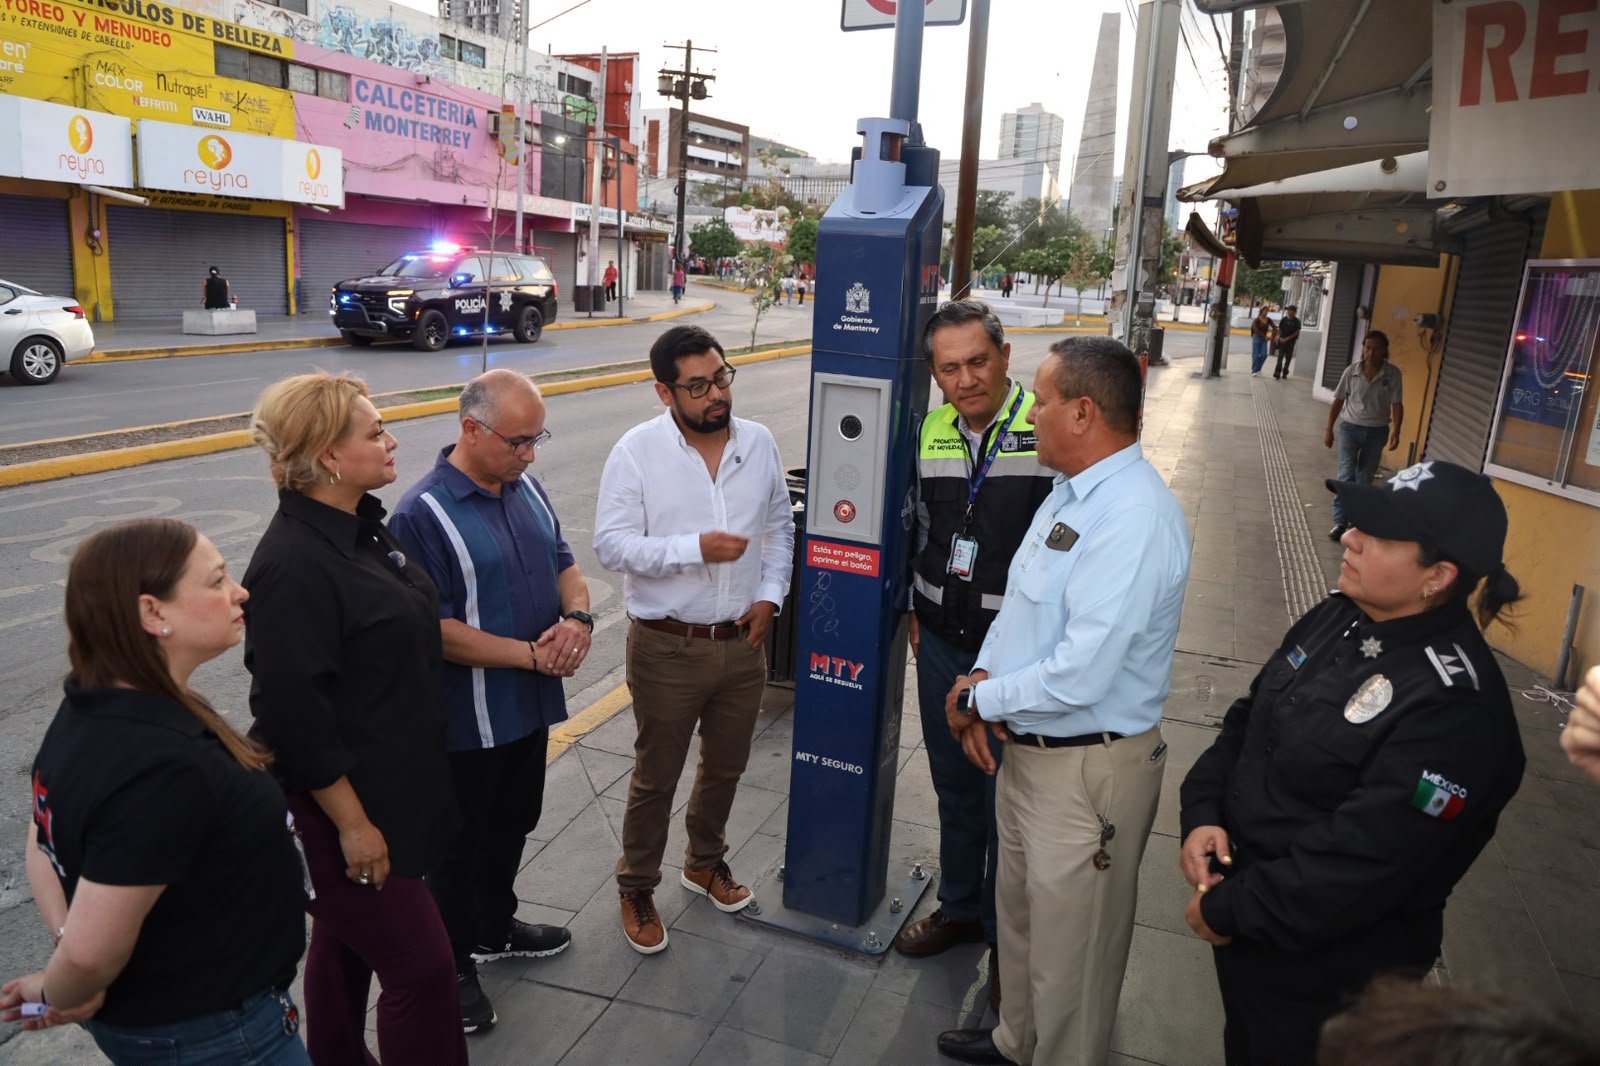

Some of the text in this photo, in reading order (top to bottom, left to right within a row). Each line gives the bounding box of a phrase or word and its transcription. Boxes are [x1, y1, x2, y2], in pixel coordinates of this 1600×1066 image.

[11, 14, 17, 23] Y
[20, 17, 78, 39] EXTENSIONES
[81, 31, 92, 42] DE
[72, 10, 87, 27] Y
[94, 15, 172, 47] MENUDEO
[182, 13, 205, 33] DE
[212, 20, 282, 53] BELLEZA
[96, 59, 126, 77] MAX
[94, 72, 144, 93] COLOR
[355, 79, 478, 129] CALCETERIA
[195, 109, 230, 125] WAHL
[364, 109, 472, 150] MONTERREY
[58, 152, 106, 181] reyna
[183, 168, 249, 192] reyna
[298, 179, 330, 199] reyna
[455, 295, 487, 310] POLICÍA
[832, 322, 880, 335] de Monterrey
[840, 315, 873, 324] Gobierno
[812, 545, 832, 555] Estás
[844, 551, 873, 562] peligro,
[812, 556, 840, 566] oprime
[849, 561, 873, 571] botón
[810, 651, 864, 681] MTY
[834, 678, 863, 691] RESUELVE
[795, 751, 864, 775] MTY SEGURO
[1422, 769, 1468, 799] MÉXICO
